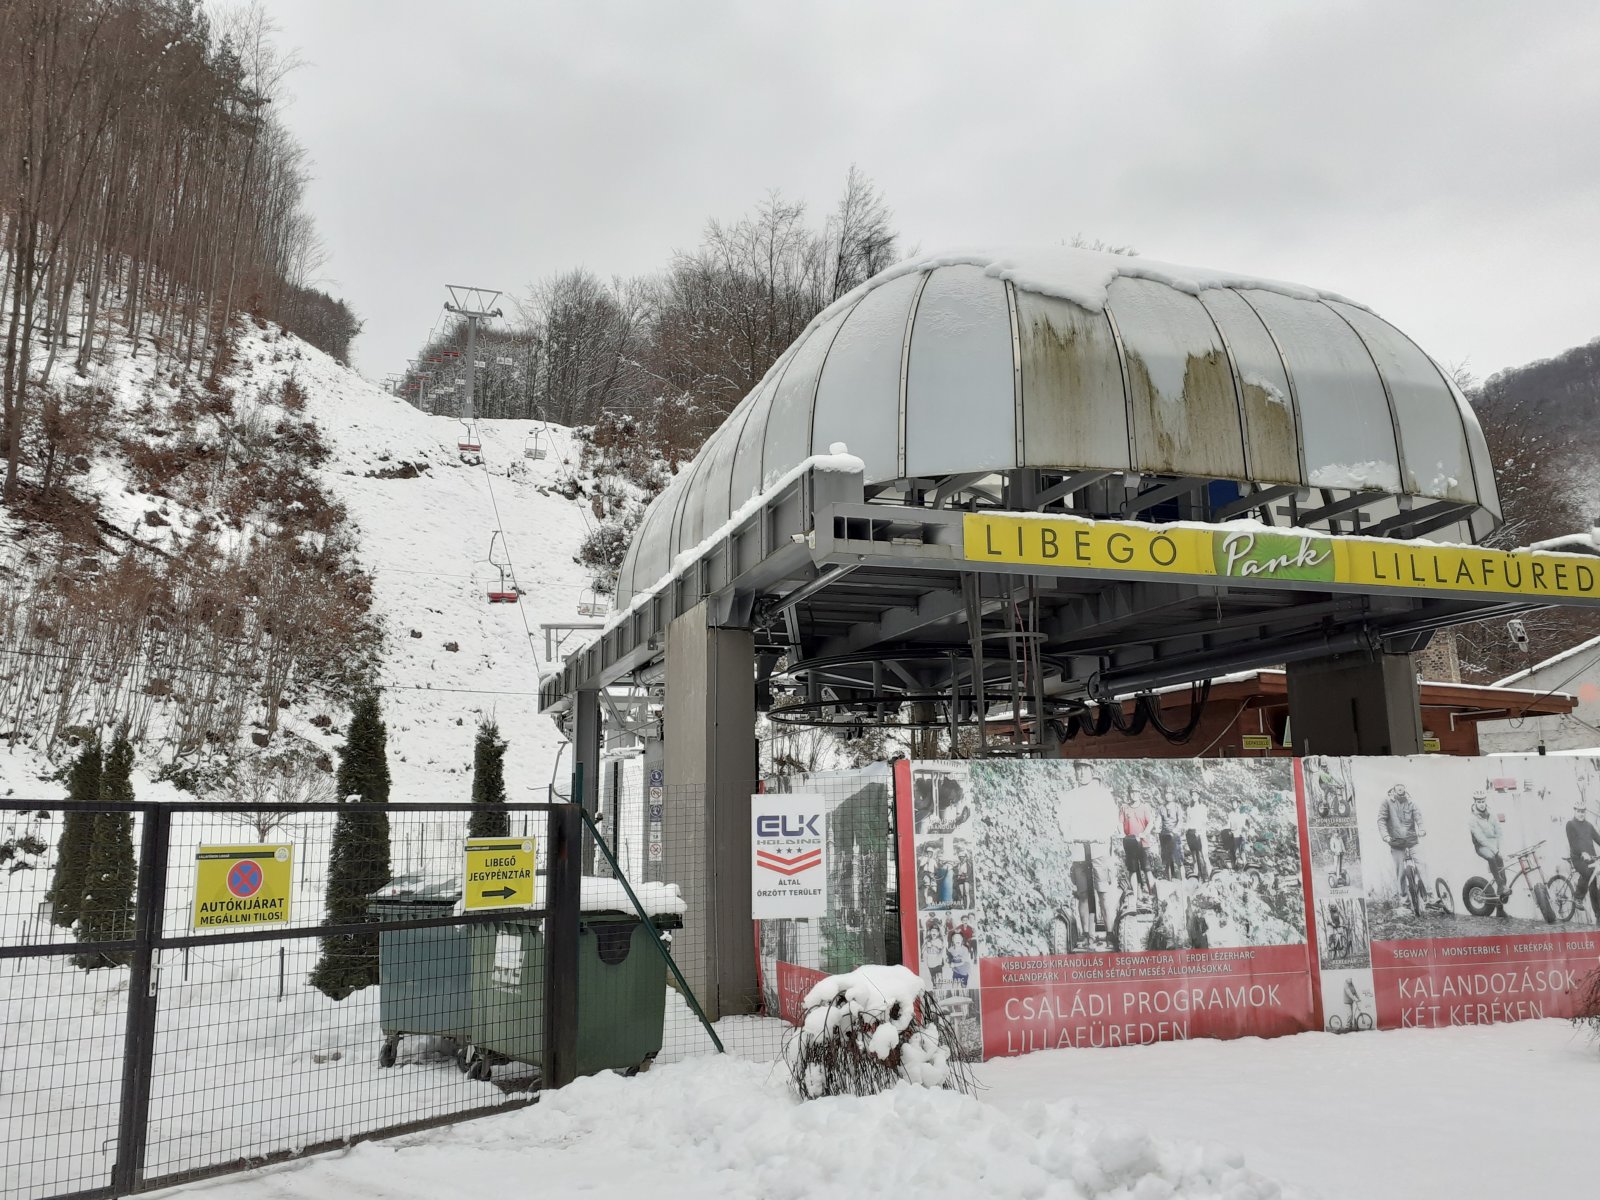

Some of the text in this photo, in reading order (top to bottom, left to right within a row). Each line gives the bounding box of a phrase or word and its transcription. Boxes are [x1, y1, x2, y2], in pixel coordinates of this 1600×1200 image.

[1222, 531, 1331, 577] Park
[1372, 551, 1594, 592] LILLAFÜRED
[757, 814, 820, 837] ELK
[757, 838, 821, 846] HOLDING
[485, 855, 516, 868] LIBEGŐ
[468, 867, 531, 882] JEGYPÉNZTÁR
[778, 877, 801, 886] ÁLTAL
[789, 887, 822, 896] TERÜLET
[200, 897, 285, 913] AUTÓKIJÁRAT
[200, 911, 283, 925] MEGÁLLNI TILOS!
[1393, 940, 1595, 959] SEGWAY MONSTERBIKE KERÉKPÁR ROLLER
[1001, 950, 1256, 971] KISBUSZOS KIRÁNDULÁS SEGWAY-TÚRA ERDEI LÉZERHARC
[1002, 962, 1233, 983] KALANDPARK OXIGÉN SÉTAÚT MESÉS ÁLLOMÁSOKKAL
[1398, 965, 1579, 1000] KALANDOZÁSOK
[1005, 983, 1281, 1021] CSALÁDI PROGRAMOK
[1401, 996, 1544, 1029] KÉT KERÉKEN
[1007, 1020, 1188, 1053] LILLAFÜREDEN
